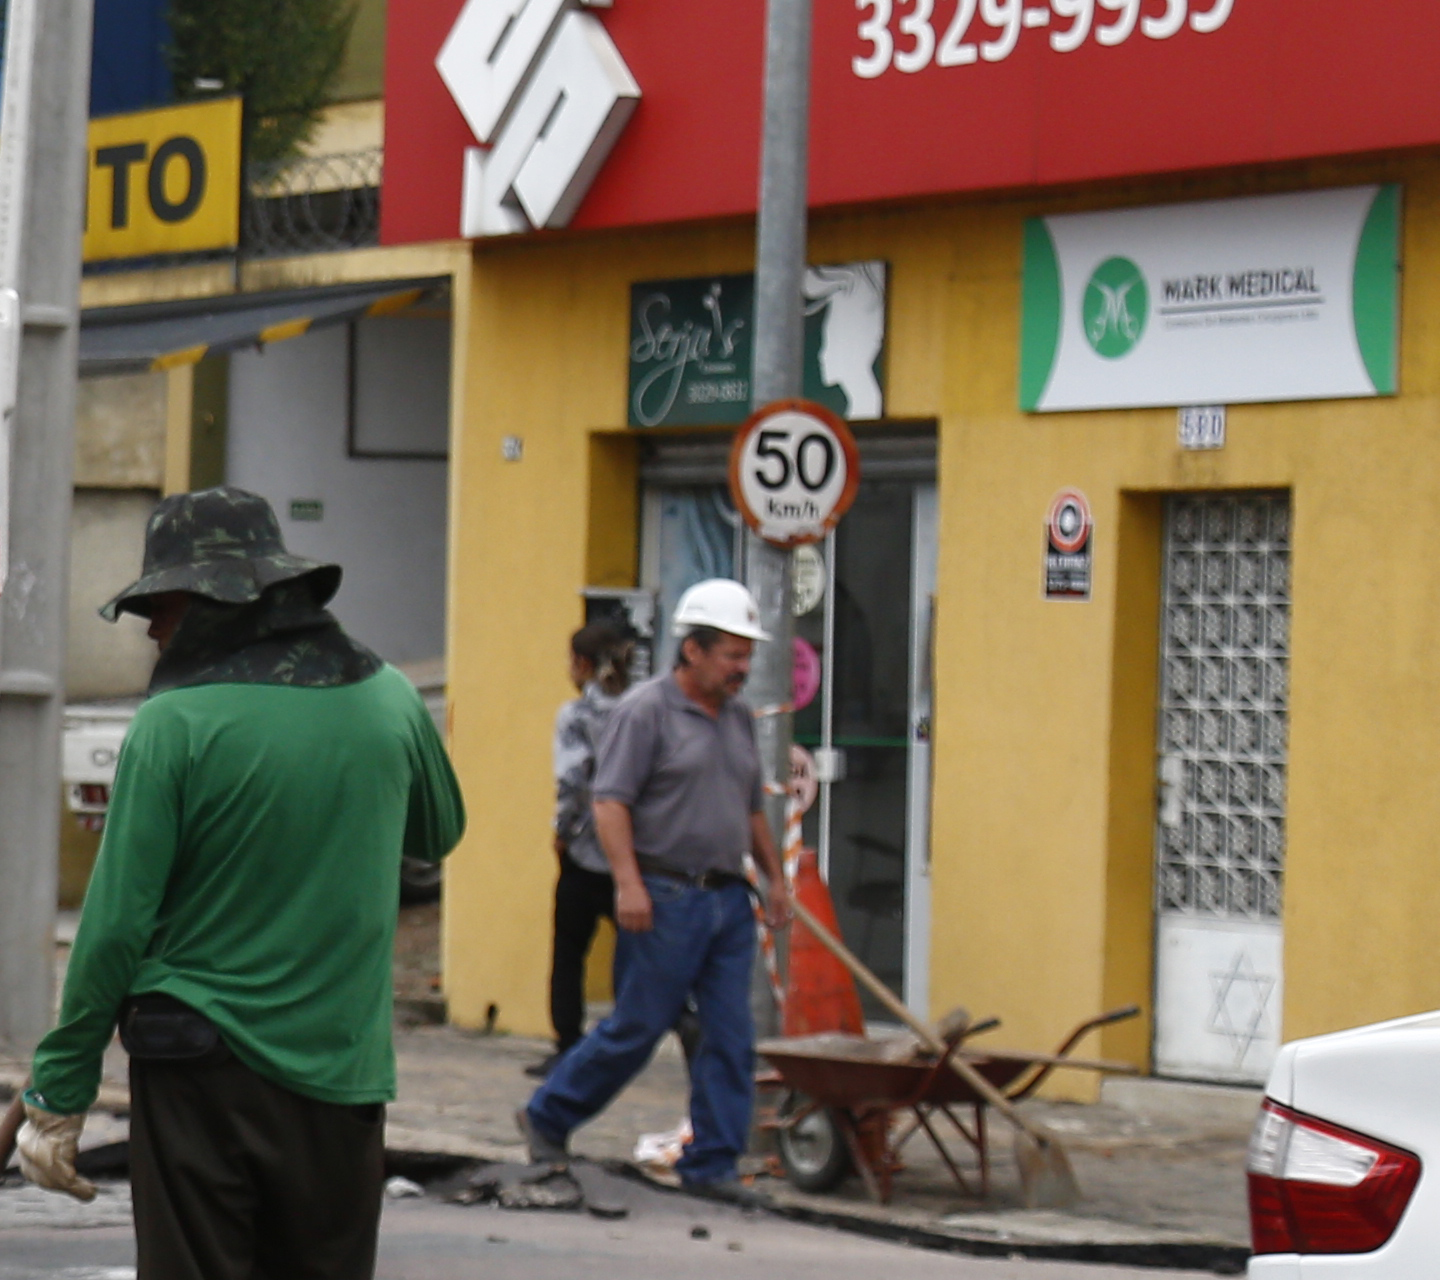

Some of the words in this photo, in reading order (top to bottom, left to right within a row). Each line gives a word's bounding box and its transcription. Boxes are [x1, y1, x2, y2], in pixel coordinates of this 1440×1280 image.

[1161, 273, 1221, 303] MARK
[1227, 267, 1320, 298] MEDICAL
[754, 431, 836, 491] 50
[766, 497, 820, 519] km/h
